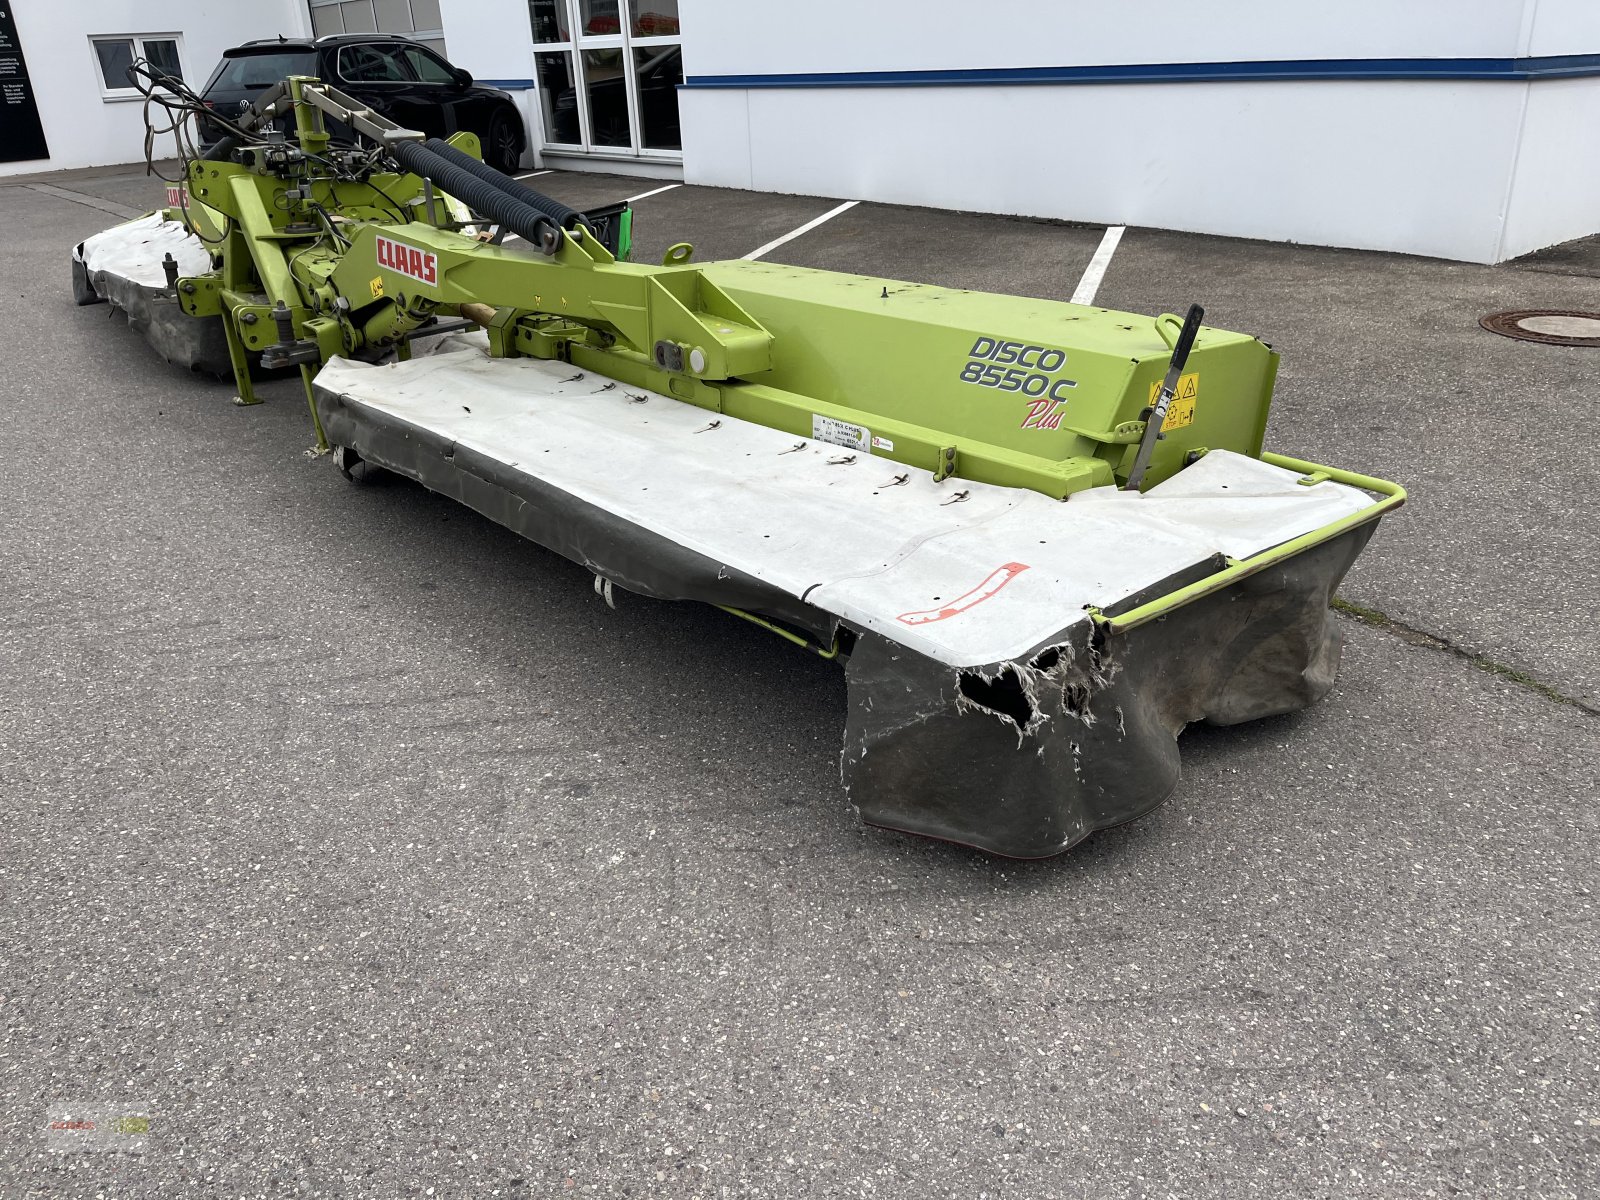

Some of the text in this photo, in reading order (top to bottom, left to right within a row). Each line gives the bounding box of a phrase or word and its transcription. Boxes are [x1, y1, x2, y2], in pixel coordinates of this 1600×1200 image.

[377, 238, 436, 284] CLAAS
[968, 336, 1067, 372] DISCO
[1020, 399, 1065, 430] Plus
